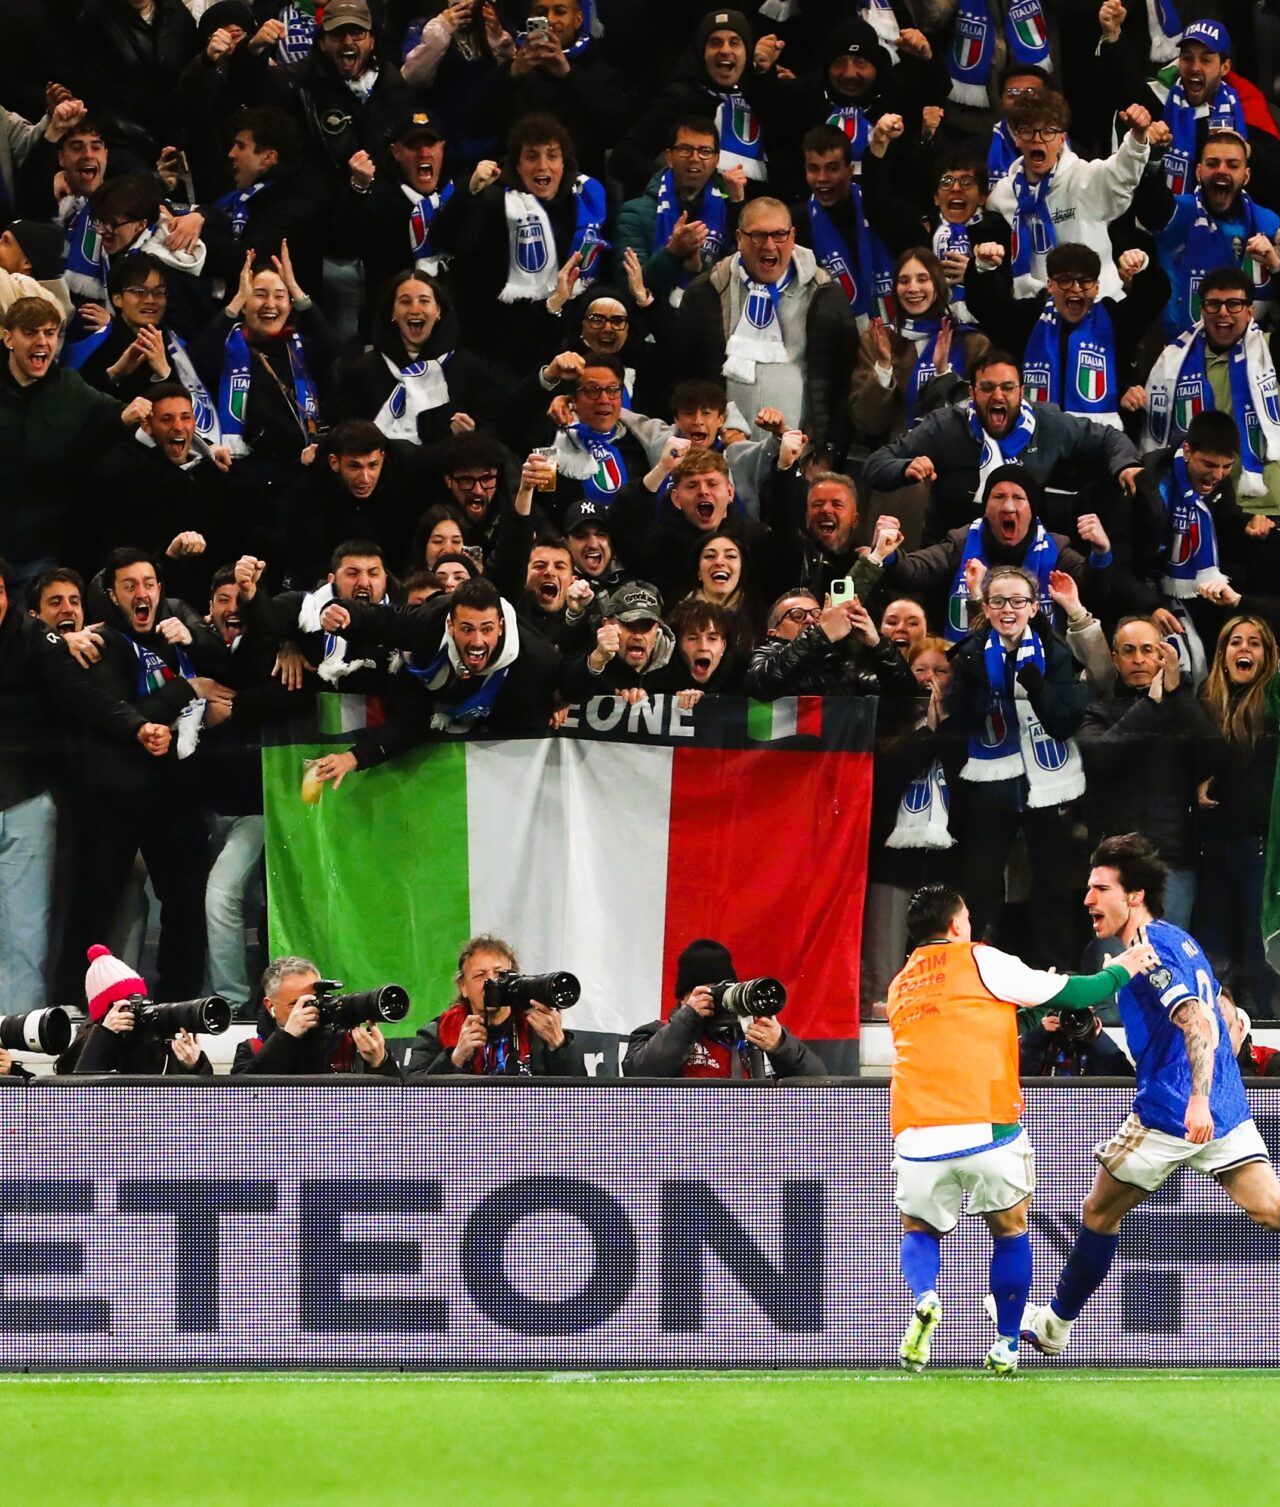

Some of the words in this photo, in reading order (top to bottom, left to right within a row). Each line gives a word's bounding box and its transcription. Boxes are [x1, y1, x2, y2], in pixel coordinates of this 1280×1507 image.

[1011, 3, 1037, 21] ITALIA
[1186, 22, 1219, 40] ITALIA
[1080, 353, 1103, 367] ITALIA
[1022, 373, 1047, 385] ITALIA
[1177, 384, 1200, 397] ITALIA
[580, 501, 595, 514] NY
[0, 1175, 824, 1337] ETEON
